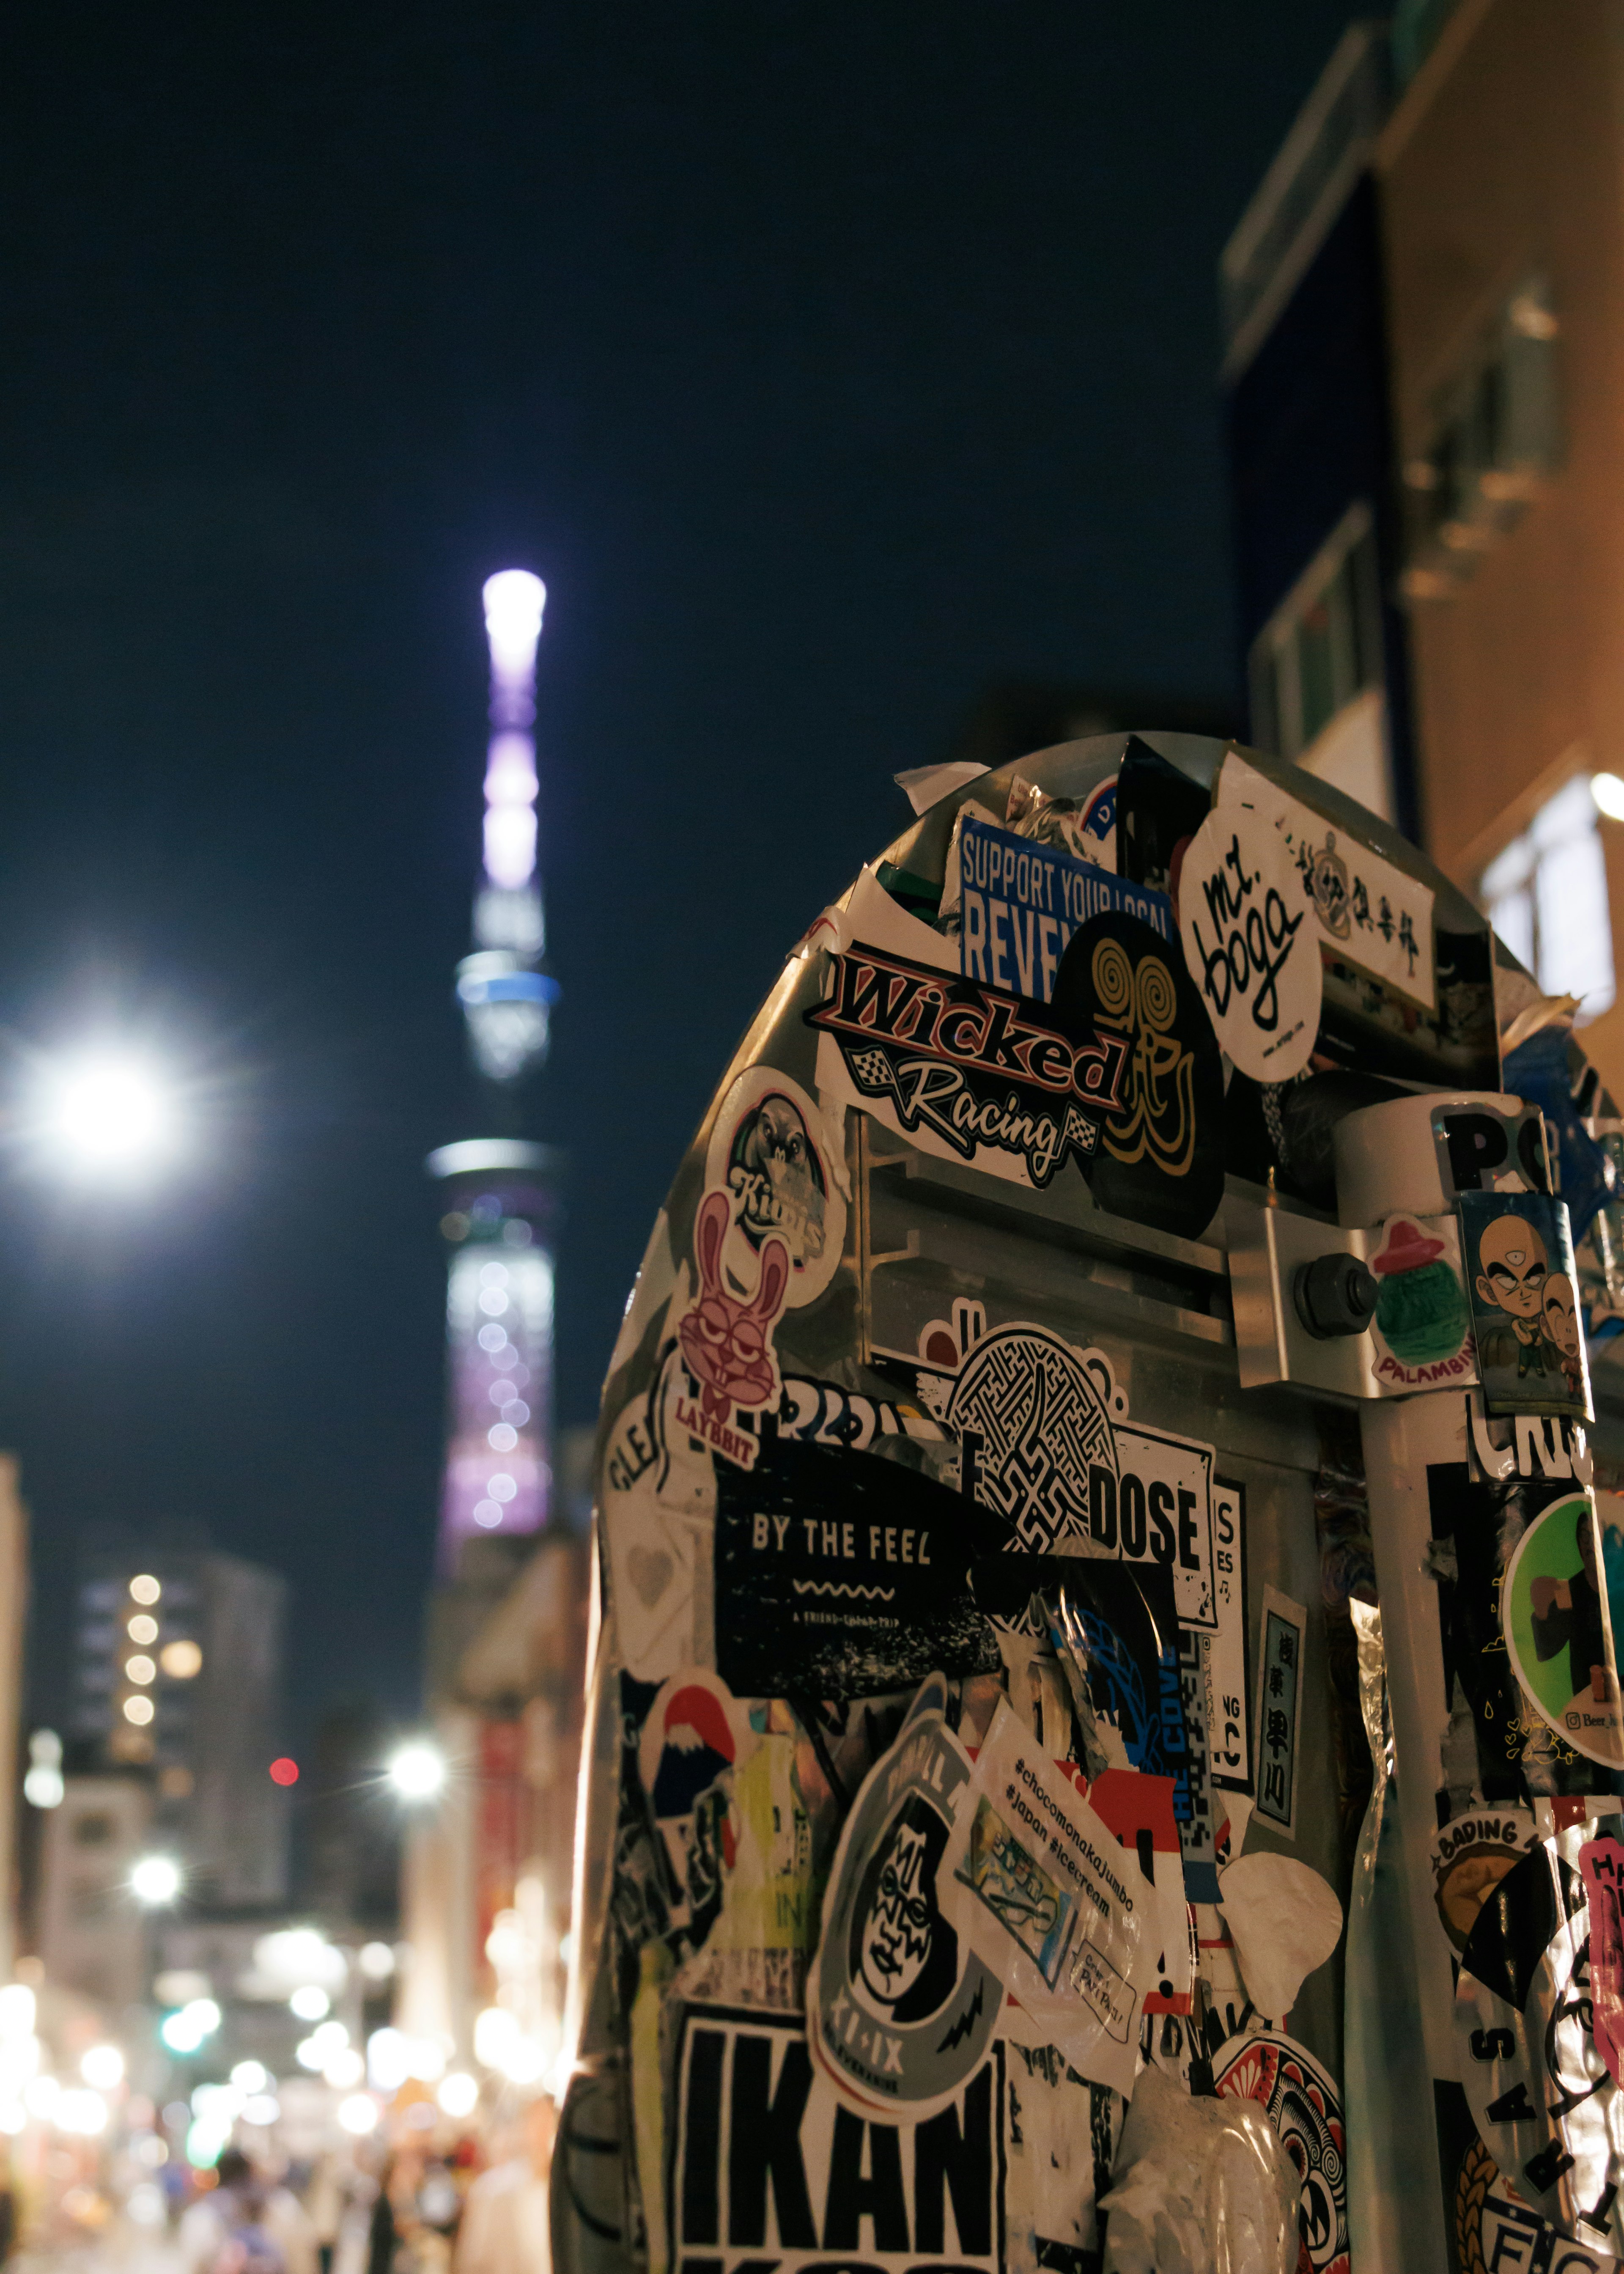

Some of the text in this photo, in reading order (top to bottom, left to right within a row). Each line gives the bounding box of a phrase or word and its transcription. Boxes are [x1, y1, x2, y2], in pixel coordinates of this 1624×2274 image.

[963, 831, 1054, 912] SUPPORT
[963, 888, 1079, 1005] REVE
[836, 963, 1130, 1112] Wicked
[897, 1060, 1061, 1178] Racing
[675, 1397, 754, 1464] LAYBBIT
[752, 1512, 930, 1565] BY THE FEEL
[1015, 1758, 1133, 1912] #chocomonakajumbo
[1439, 1818, 1517, 1860] BADING
